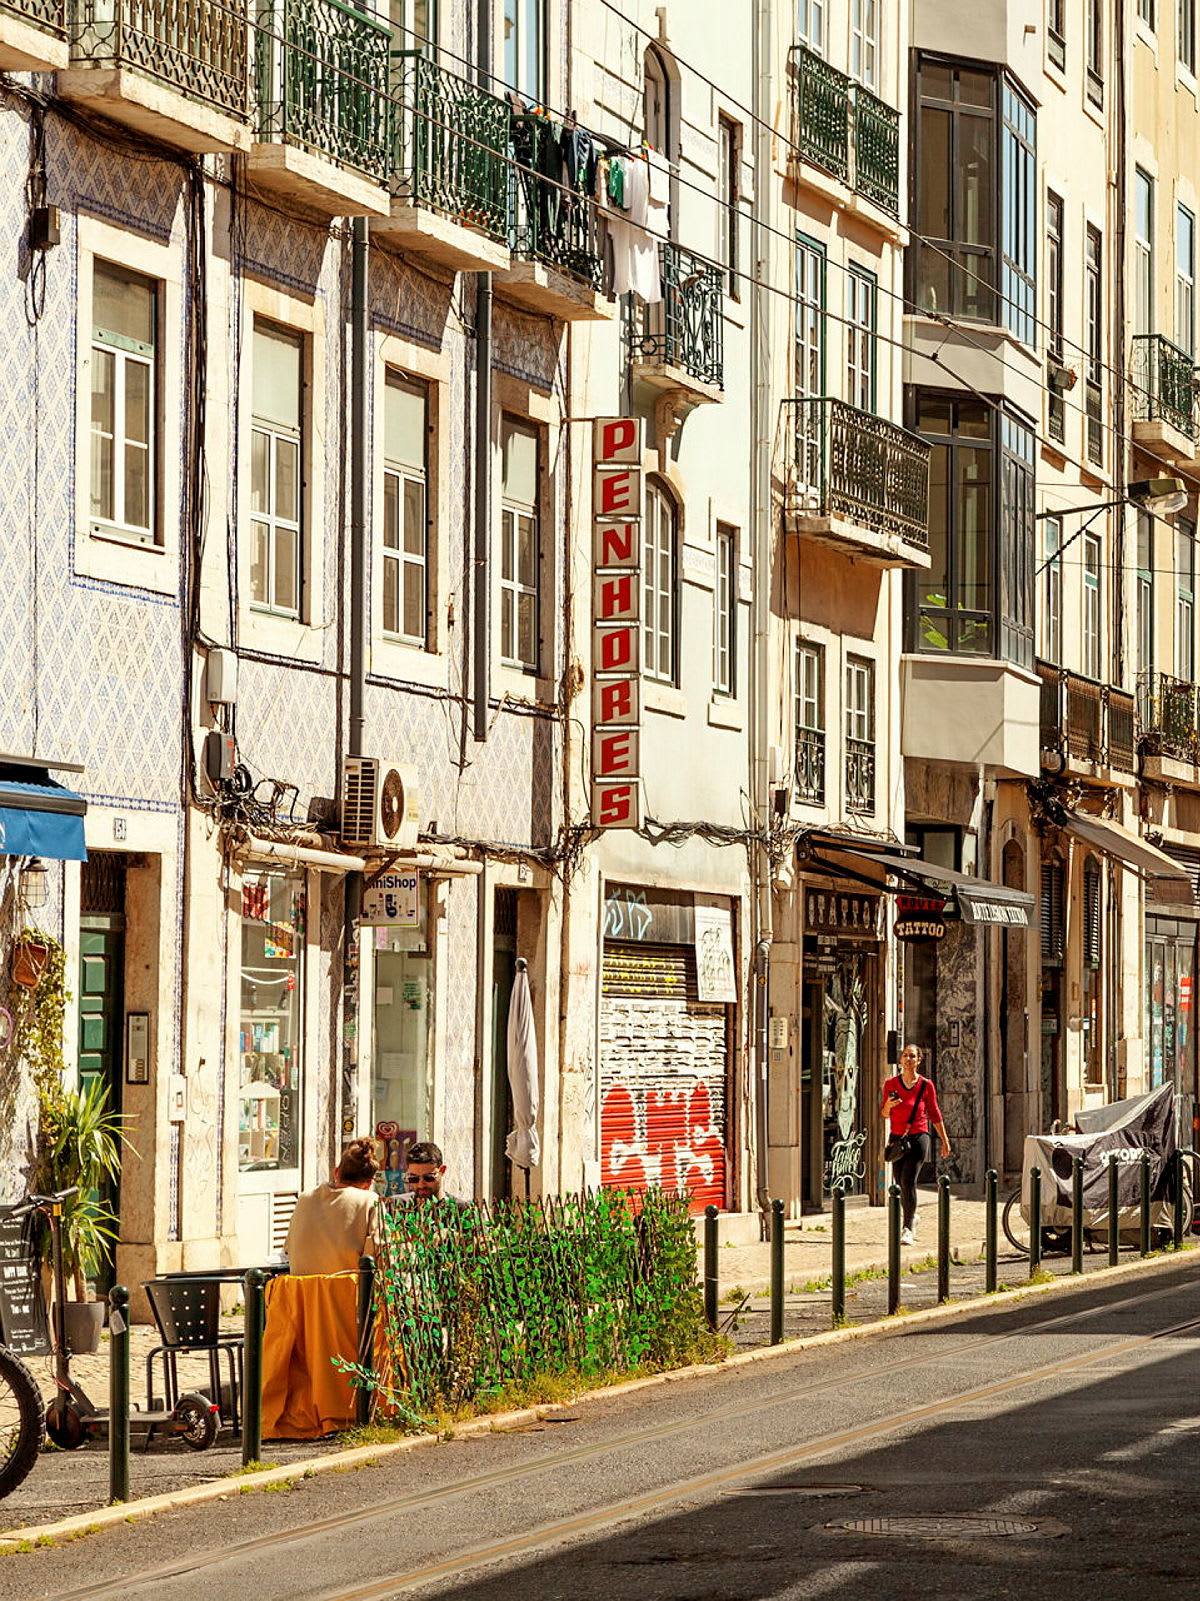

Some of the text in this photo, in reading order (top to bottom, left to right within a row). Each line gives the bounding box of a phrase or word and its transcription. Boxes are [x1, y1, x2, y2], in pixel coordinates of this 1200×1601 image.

[600, 419, 635, 826] PENHORES
[369, 875, 416, 890] iniShop
[896, 921, 944, 937] TATTOO
